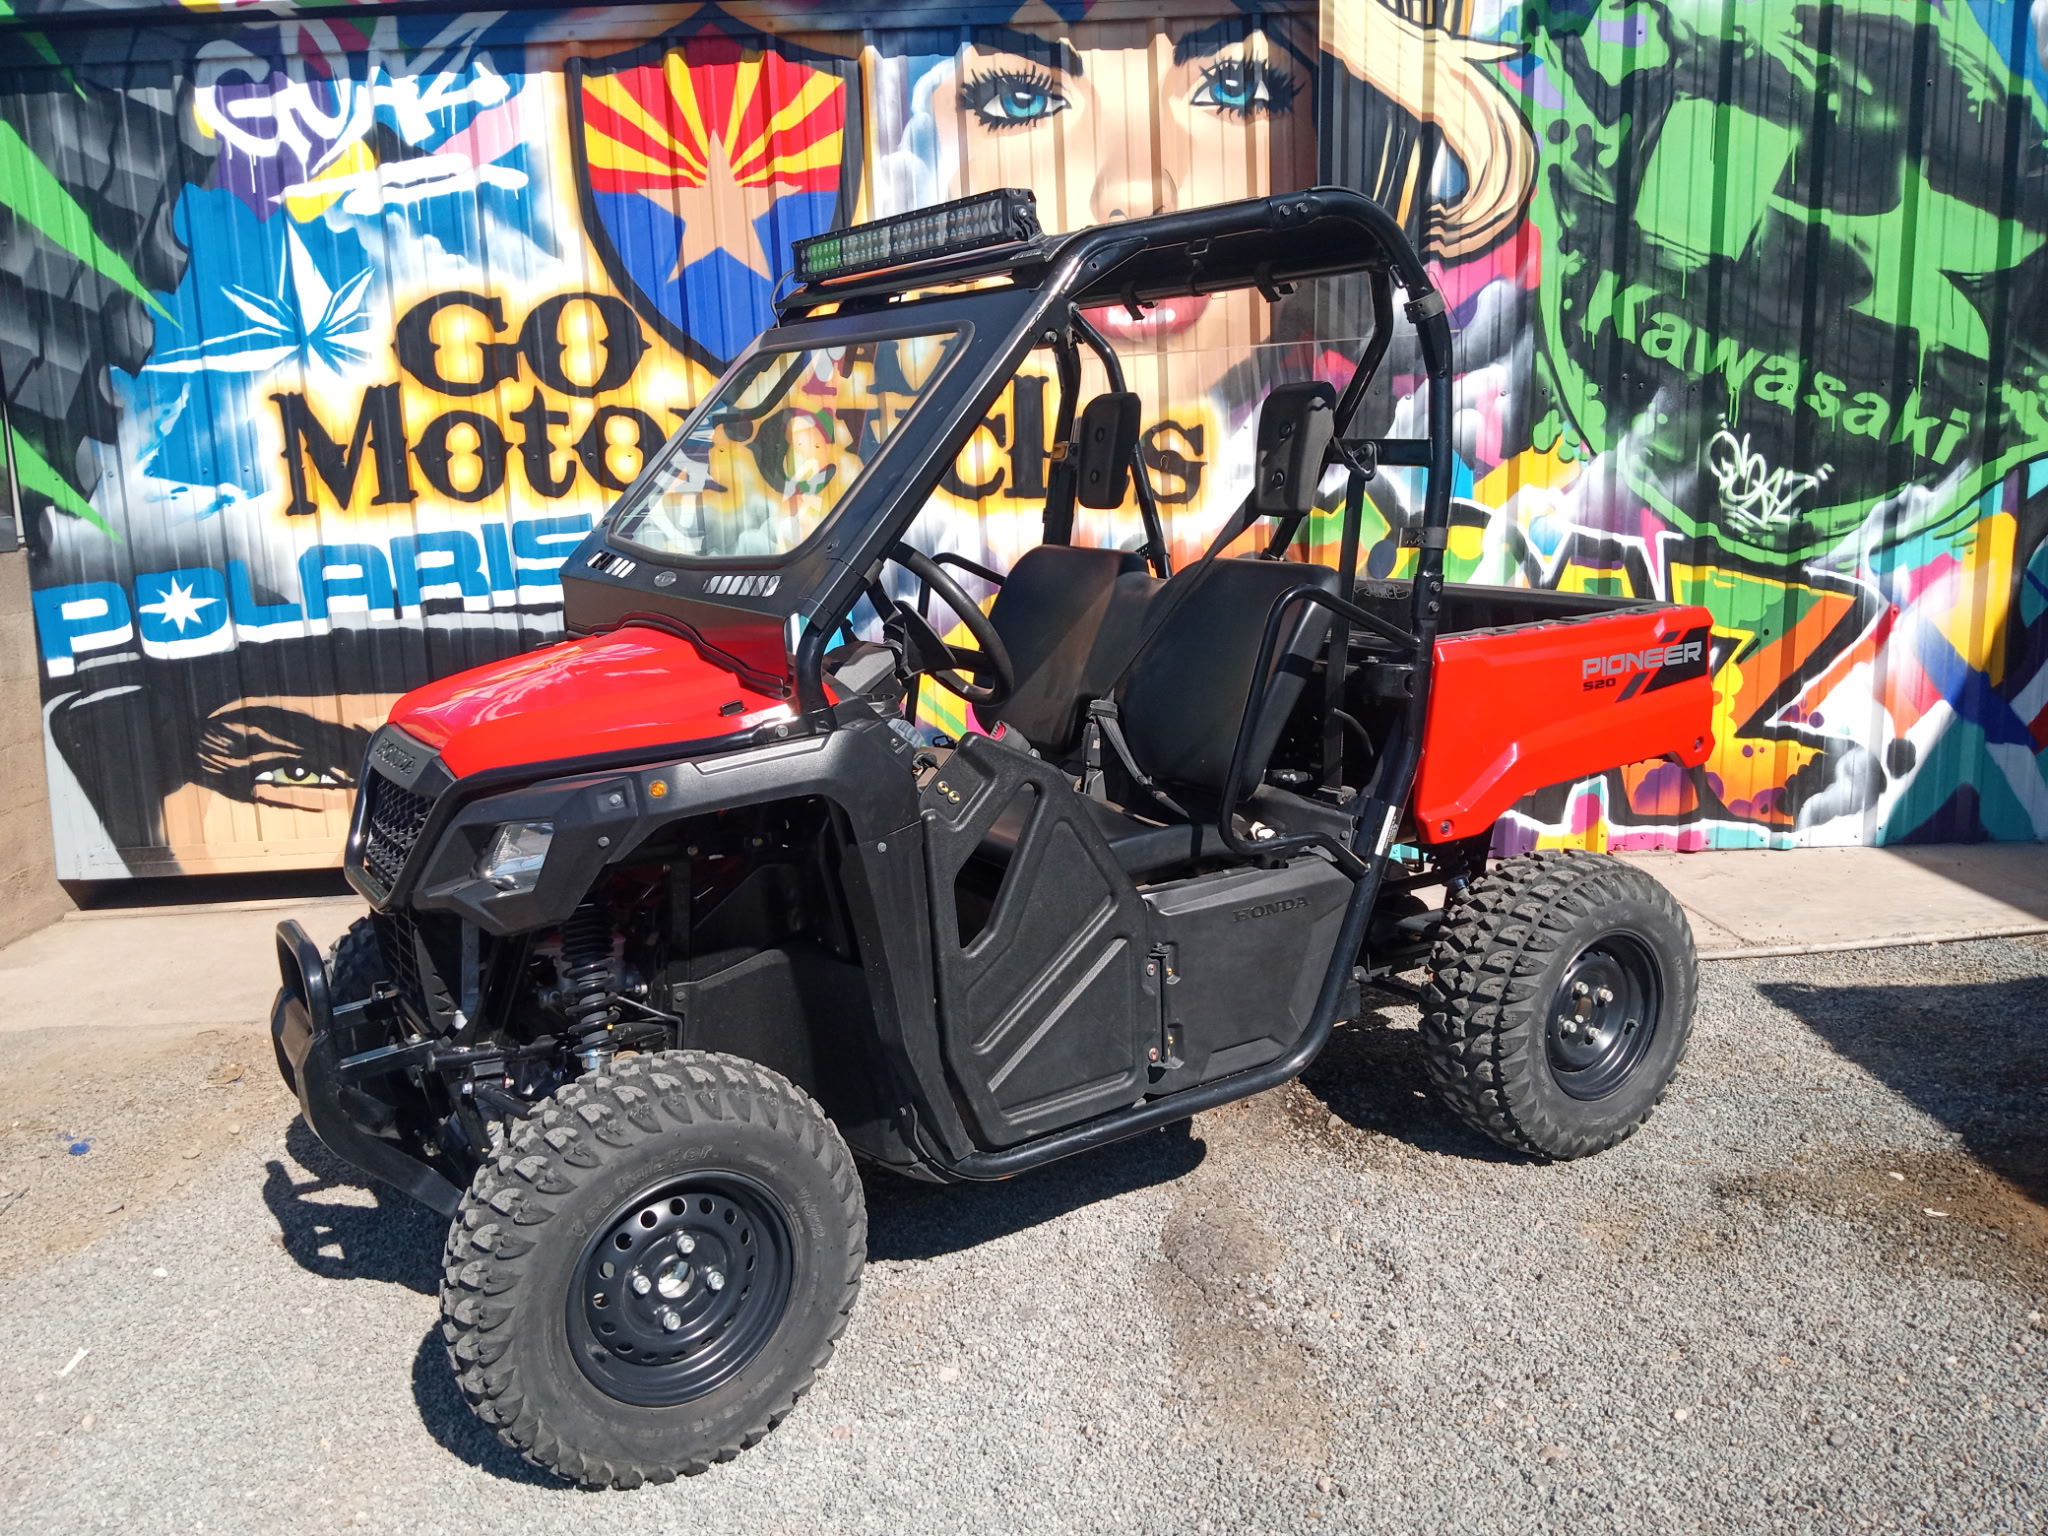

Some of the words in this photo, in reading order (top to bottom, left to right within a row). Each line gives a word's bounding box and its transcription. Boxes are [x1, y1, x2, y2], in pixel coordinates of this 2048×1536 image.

[391, 291, 651, 397] GO
[1579, 270, 1971, 465] Kawasaki
[32, 513, 594, 668] POLARIS
[1582, 641, 1702, 679] PIONEER
[1583, 678, 1616, 691] 520
[1232, 896, 1311, 923] HONDA
